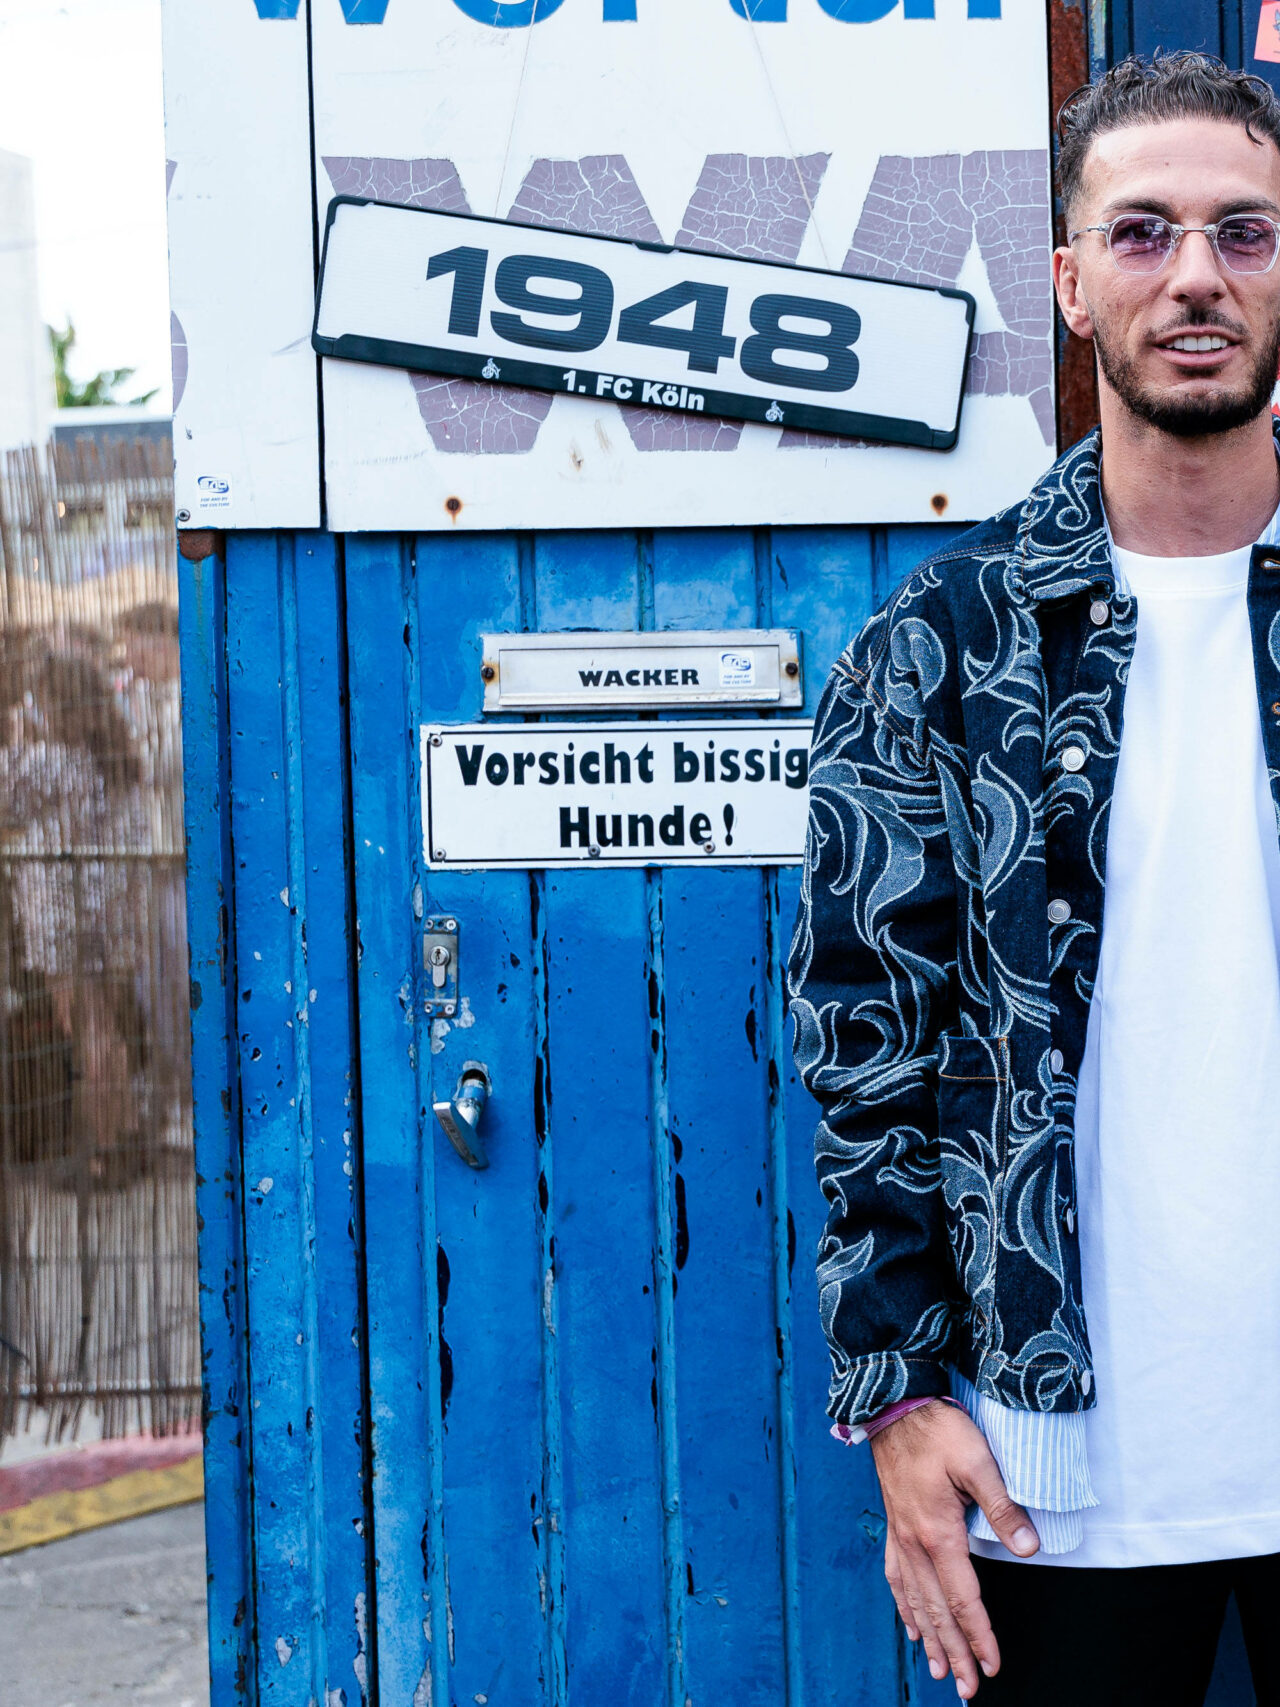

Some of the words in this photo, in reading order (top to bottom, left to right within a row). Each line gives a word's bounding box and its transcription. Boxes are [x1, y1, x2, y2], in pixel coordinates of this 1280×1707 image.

[426, 246, 861, 392] 1948
[563, 370, 586, 393] 1.
[596, 374, 633, 400] FC
[641, 381, 705, 411] Köln
[578, 669, 700, 687] WACKER
[454, 742, 655, 787] Vorsicht
